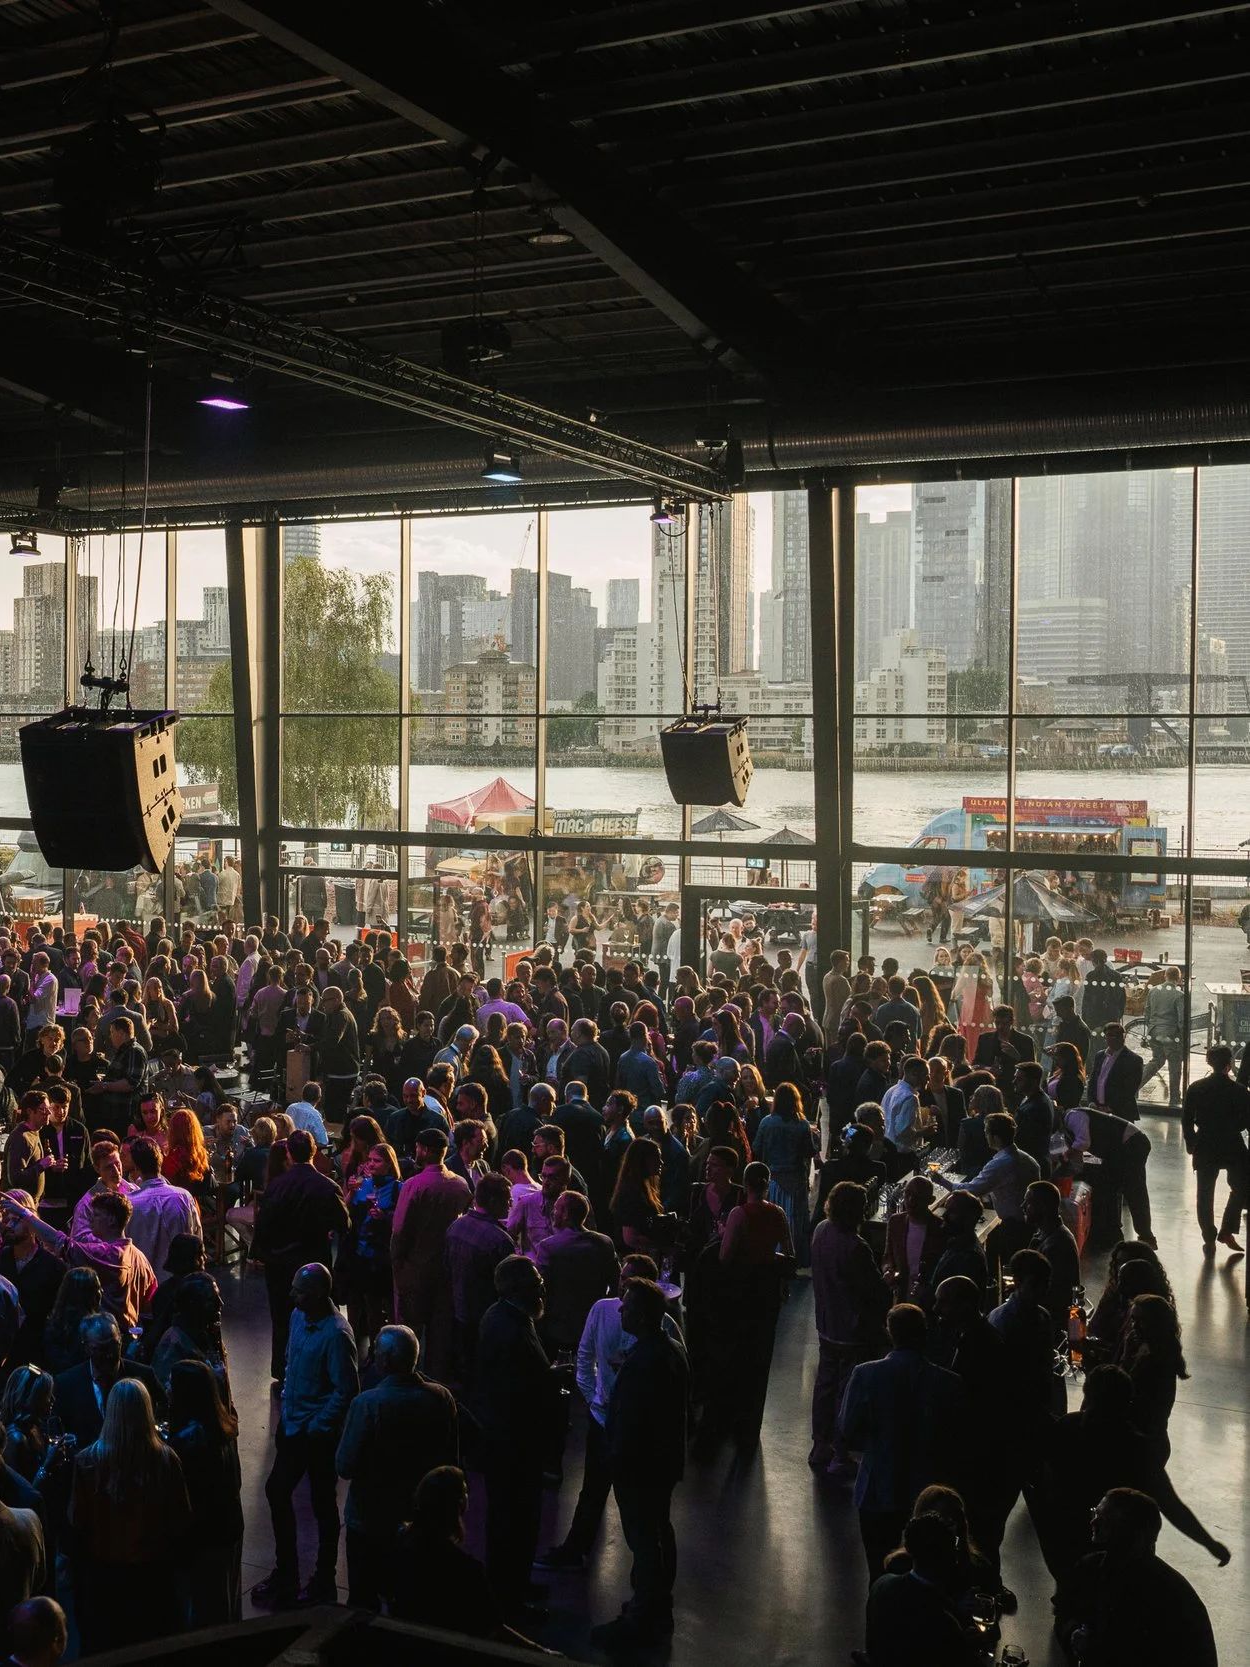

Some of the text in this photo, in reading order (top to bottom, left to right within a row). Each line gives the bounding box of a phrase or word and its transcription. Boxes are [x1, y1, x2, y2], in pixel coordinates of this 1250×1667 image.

[184, 796, 201, 810] KEN
[970, 799, 1019, 807] ULTIMAE
[554, 818, 583, 834] MAC
[591, 817, 637, 833] CHEESE
